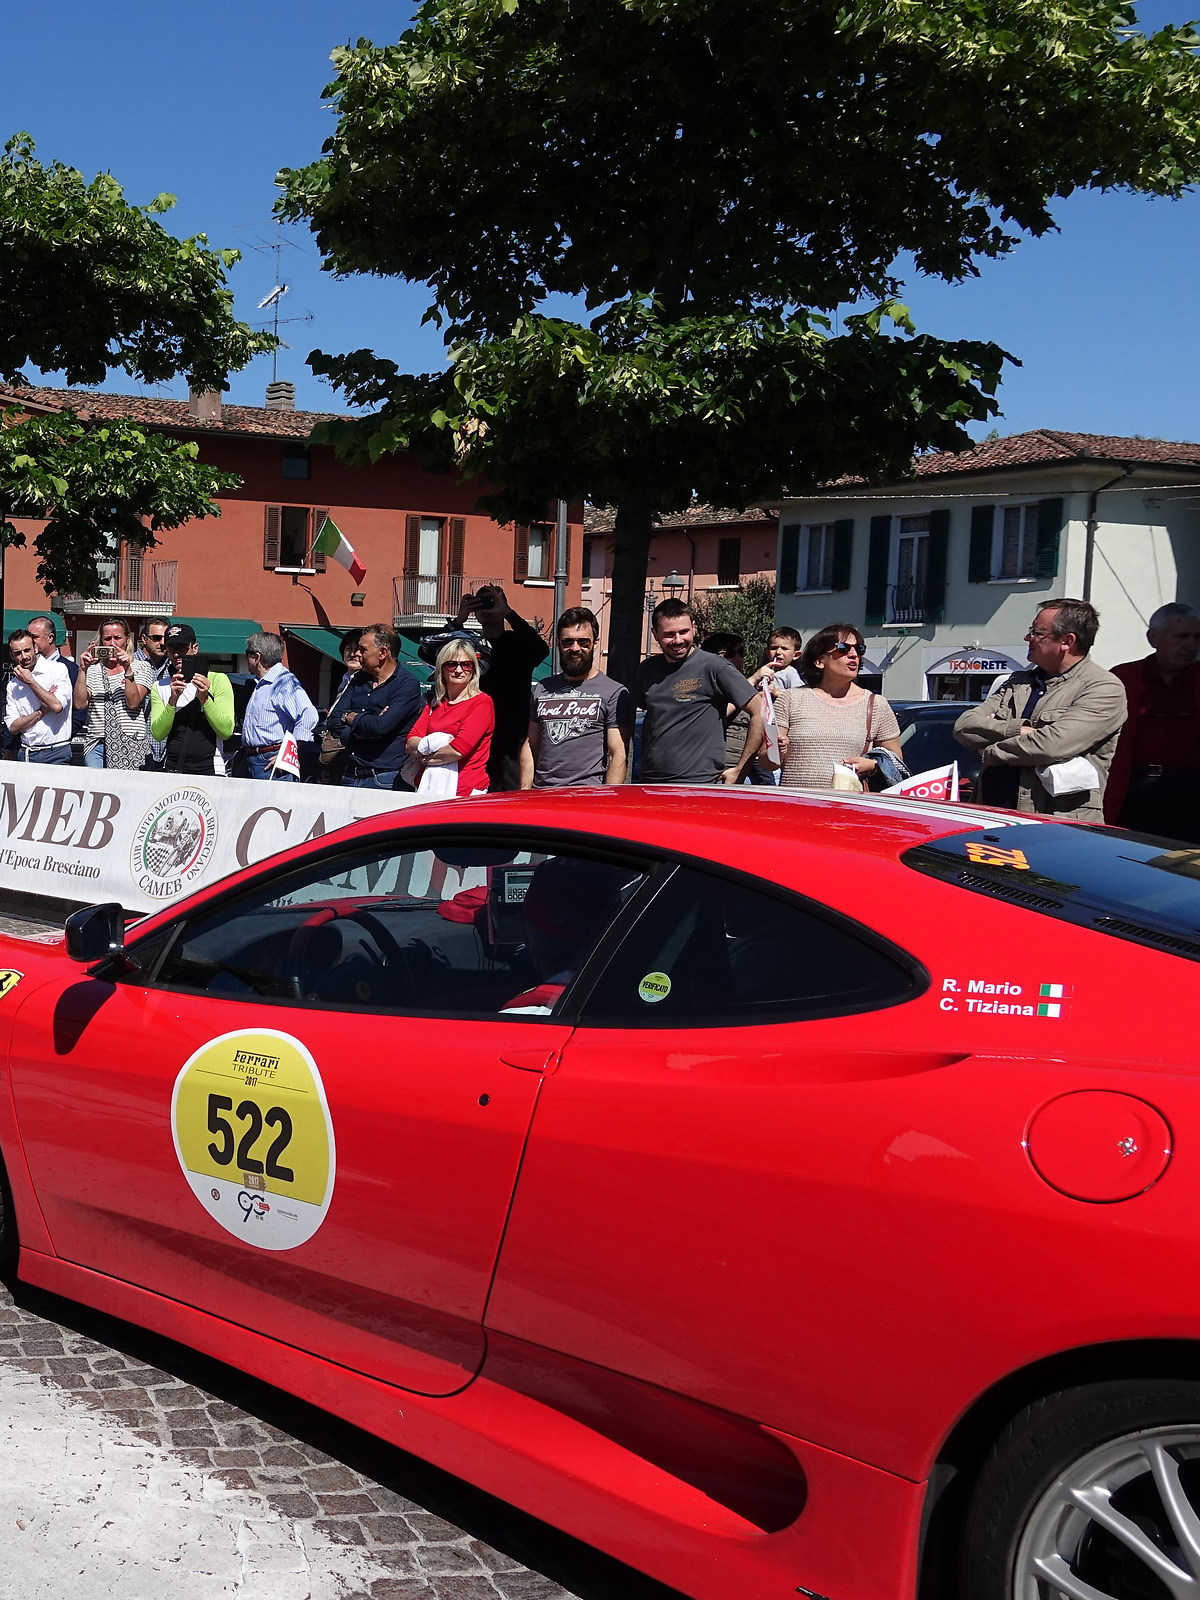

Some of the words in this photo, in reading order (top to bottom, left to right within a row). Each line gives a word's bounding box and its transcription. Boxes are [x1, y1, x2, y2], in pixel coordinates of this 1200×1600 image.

[948, 660, 1008, 670] TECNORETE
[537, 702, 563, 718] Hard
[563, 701, 597, 716] Rock
[154, 791, 180, 814] MOTO
[181, 790, 212, 818] D'EPOCA
[137, 813, 155, 842] AUTO
[186, 816, 215, 881] BRESCIANO
[965, 842, 1031, 870] 522
[43, 855, 101, 879] Bresciano
[138, 874, 183, 897] CAMEB
[642, 980, 669, 993] VERIFICATO
[942, 978, 961, 992] R.
[967, 980, 1022, 995] Mario
[939, 997, 959, 1011] C.
[965, 999, 1034, 1016] Tiziana
[233, 1050, 280, 1069] Ferrari
[232, 1063, 276, 1079] TRIBUTE
[244, 1075, 258, 1087] 2017
[207, 1093, 294, 1183] 522
